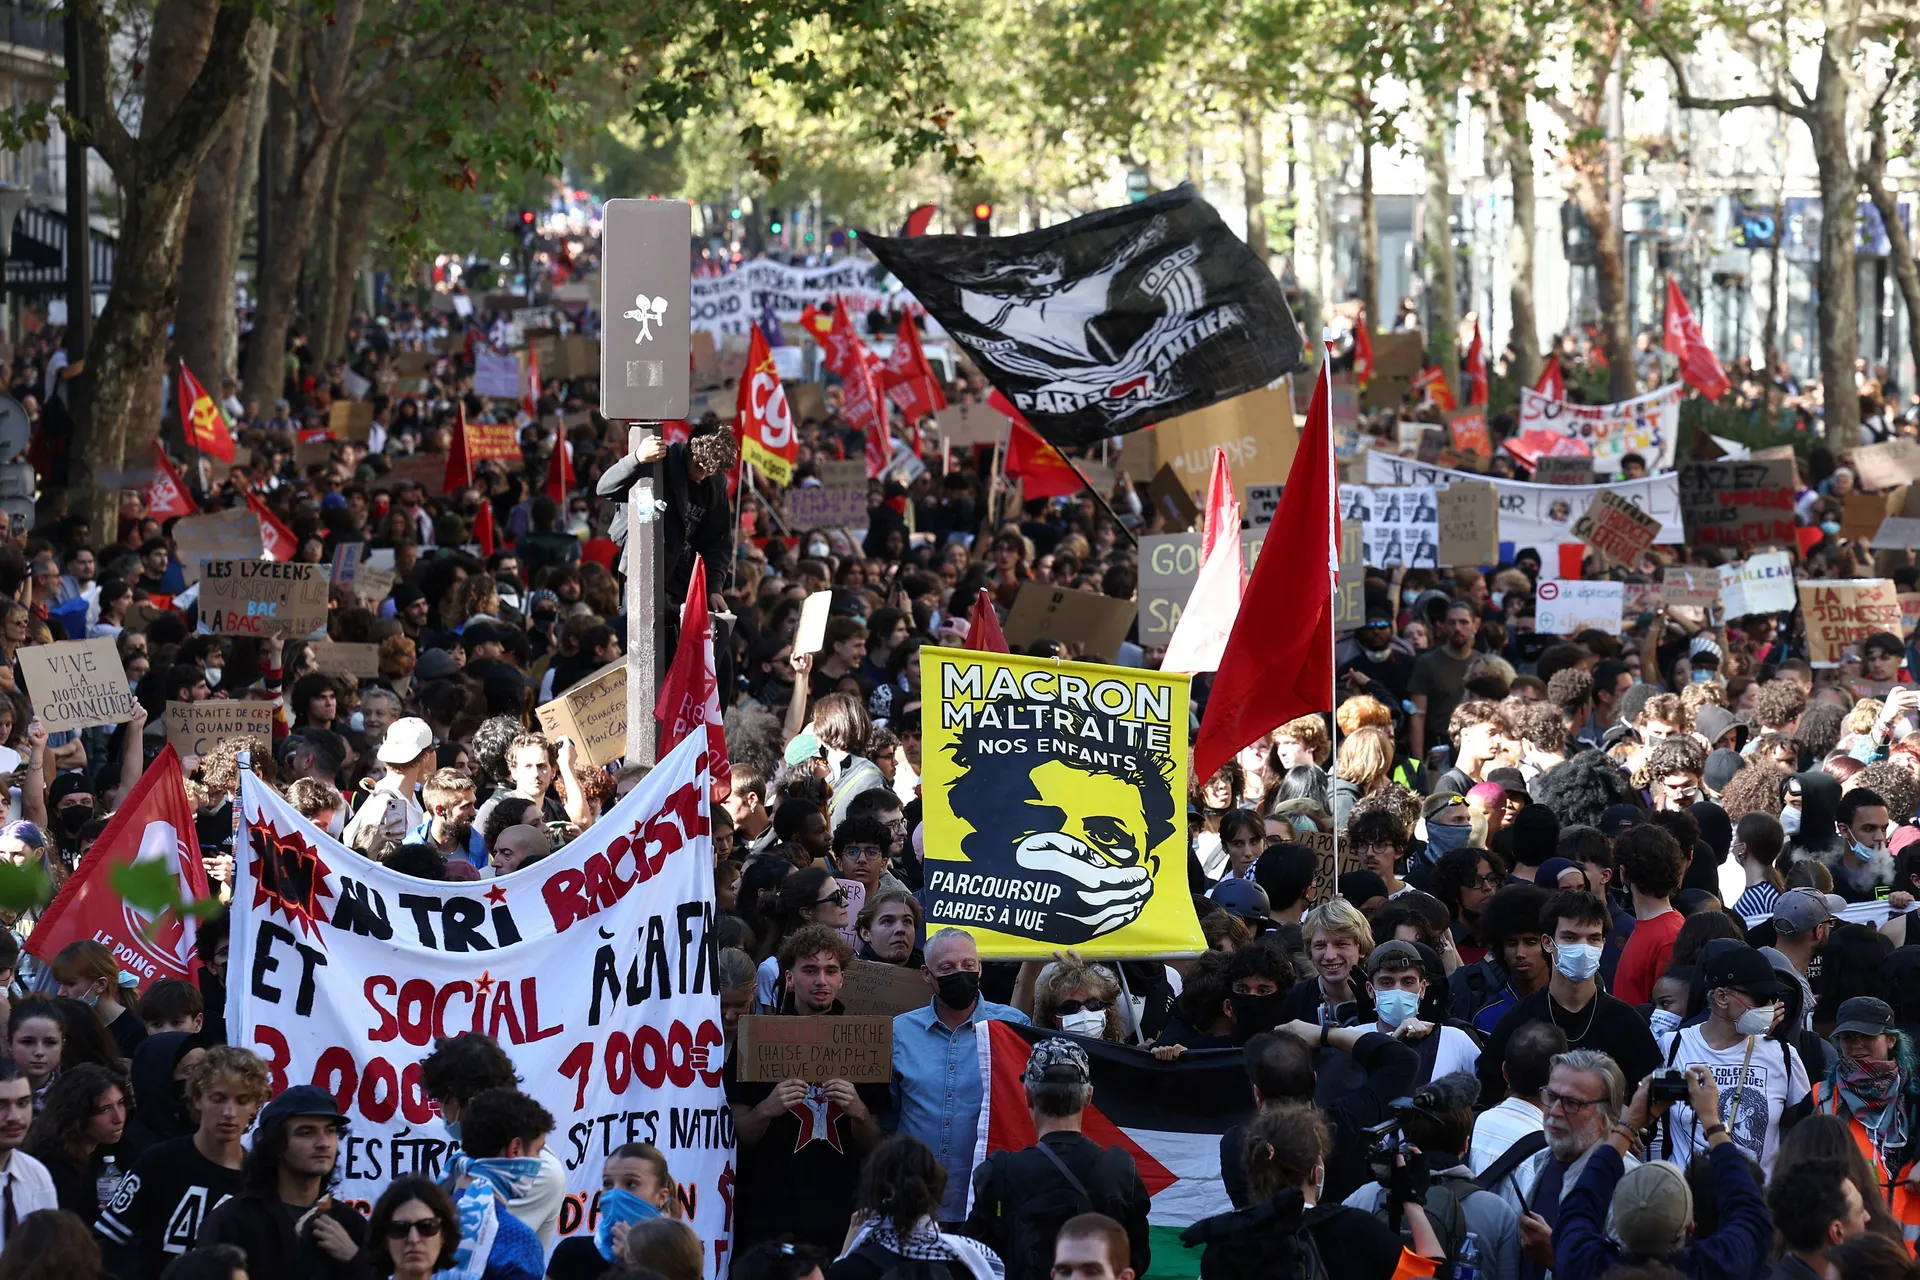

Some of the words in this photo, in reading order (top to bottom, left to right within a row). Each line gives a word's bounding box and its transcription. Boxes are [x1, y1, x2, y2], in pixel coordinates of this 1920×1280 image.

[1155, 303, 1242, 378] ANTIFA
[207, 560, 233, 579] LES
[213, 577, 296, 602] VISENT
[300, 581, 328, 605] LE
[1814, 587, 1841, 606] LA
[247, 600, 278, 617] BAC
[225, 611, 261, 633] BAC
[46, 651, 97, 673] VIVE
[69, 673, 89, 688] LA
[52, 681, 119, 703] NOUVELLE
[941, 662, 1172, 722] MACRON
[236, 708, 248, 718] DE
[251, 709, 272, 719] CR7
[181, 719, 190, 733] À
[195, 722, 243, 734] QUAND
[248, 723, 271, 734] DES
[941, 701, 1172, 754] MALTRAITE
[978, 738, 1028, 755] NOS
[1037, 738, 1137, 771] ENFANTS
[929, 870, 1062, 906] PARCOURSUP
[331, 875, 393, 942] AU
[932, 899, 995, 923] GARDES
[997, 904, 1011, 925] À
[1015, 910, 1048, 932] VUE
[92, 929, 114, 945] LE
[112, 941, 157, 979] POING
[251, 920, 327, 1017] ET
[588, 926, 622, 1027] À
[626, 914, 672, 1006] LA
[832, 1023, 885, 1046] CHERCHE
[758, 1045, 802, 1062] CHAISE
[759, 1062, 809, 1079] NEUVE
[816, 1064, 834, 1076] OU
